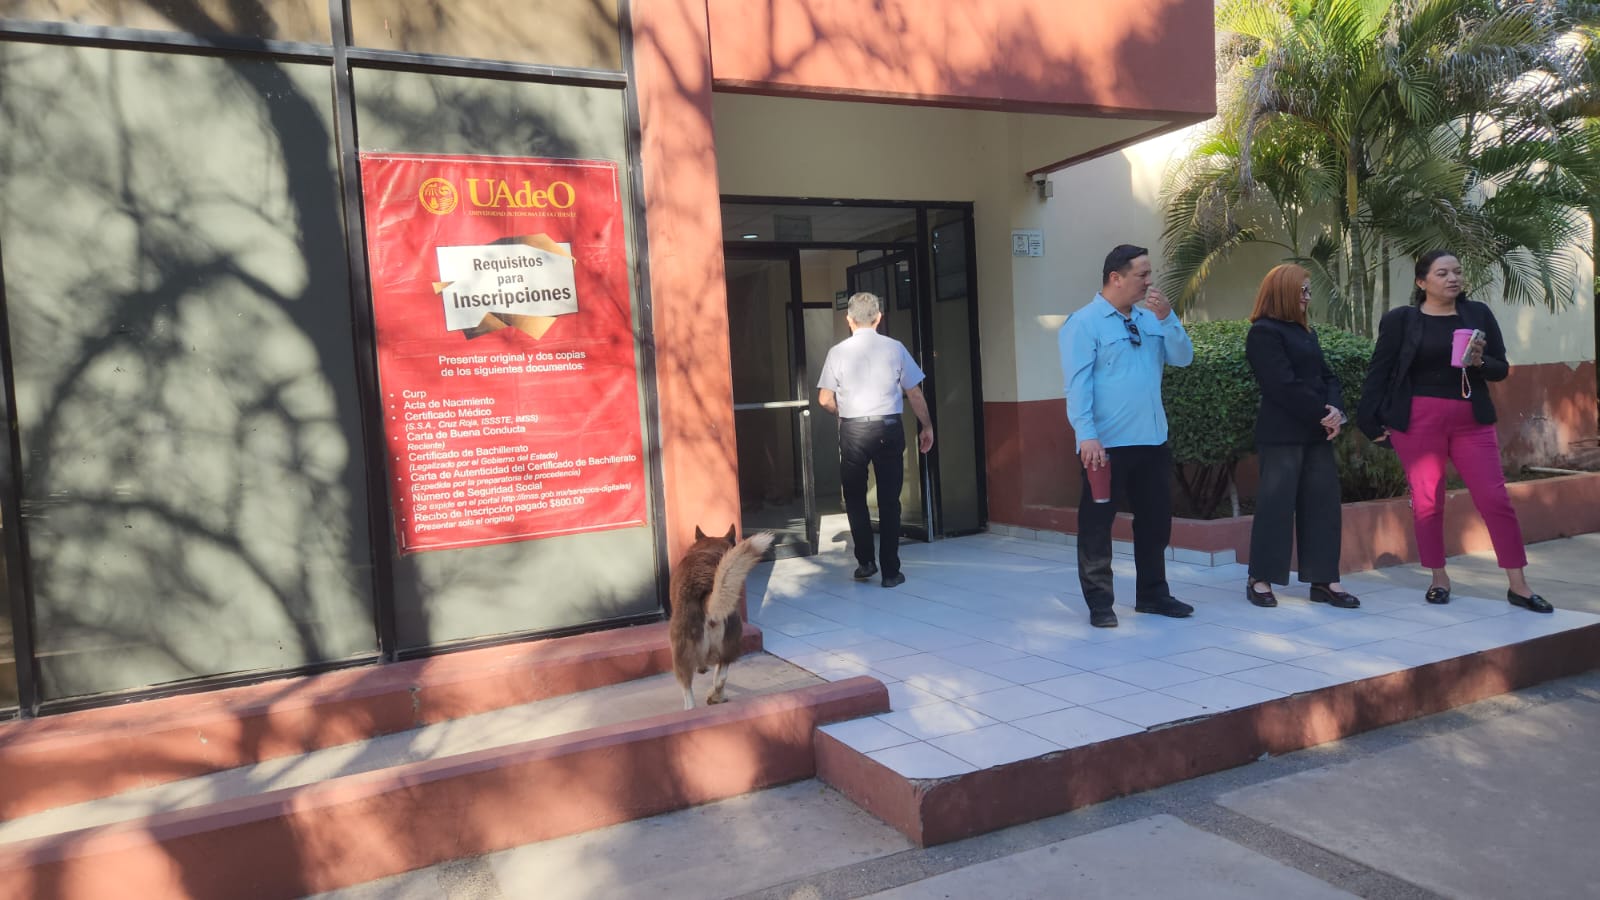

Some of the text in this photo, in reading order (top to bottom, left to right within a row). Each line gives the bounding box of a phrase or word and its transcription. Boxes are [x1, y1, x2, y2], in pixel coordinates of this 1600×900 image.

[466, 178, 576, 208] UAdeO
[473, 256, 543, 272] Requisitos
[497, 274, 524, 286] para
[453, 287, 571, 308] Inscripciones
[438, 351, 586, 365] Presentar original y dos copias
[441, 362, 585, 376] de los siguientes documentos:
[402, 390, 426, 400] Curp
[404, 397, 495, 410] Acta de Nacimiento
[405, 408, 491, 421] Certificado Médico
[516, 414, 539, 422] IMSS)
[407, 426, 526, 441] Carta de Buena Conducta
[409, 445, 528, 461] Certificado de Bachillerato
[409, 462, 455, 472] (Legalizado
[481, 456, 515, 465] Gobierno
[530, 452, 558, 460] Estado)
[410, 455, 636, 482] Carta de Autenticidad del Certificado de Bachillerato
[453, 480, 466, 488] por
[468, 478, 474, 486] la
[476, 474, 521, 485] preparatoria
[534, 469, 581, 480] procedencia)
[412, 482, 542, 502] Número de Seguridad Social
[413, 502, 427, 512] (Se
[429, 501, 455, 510] expide
[478, 496, 500, 505] portal
[415, 511, 447, 522] Recibo
[450, 510, 461, 518] de
[464, 504, 512, 516] Inscripción
[515, 501, 547, 512] pagado
[415, 522, 456, 533] (Presentar
[484, 514, 514, 524] original)
